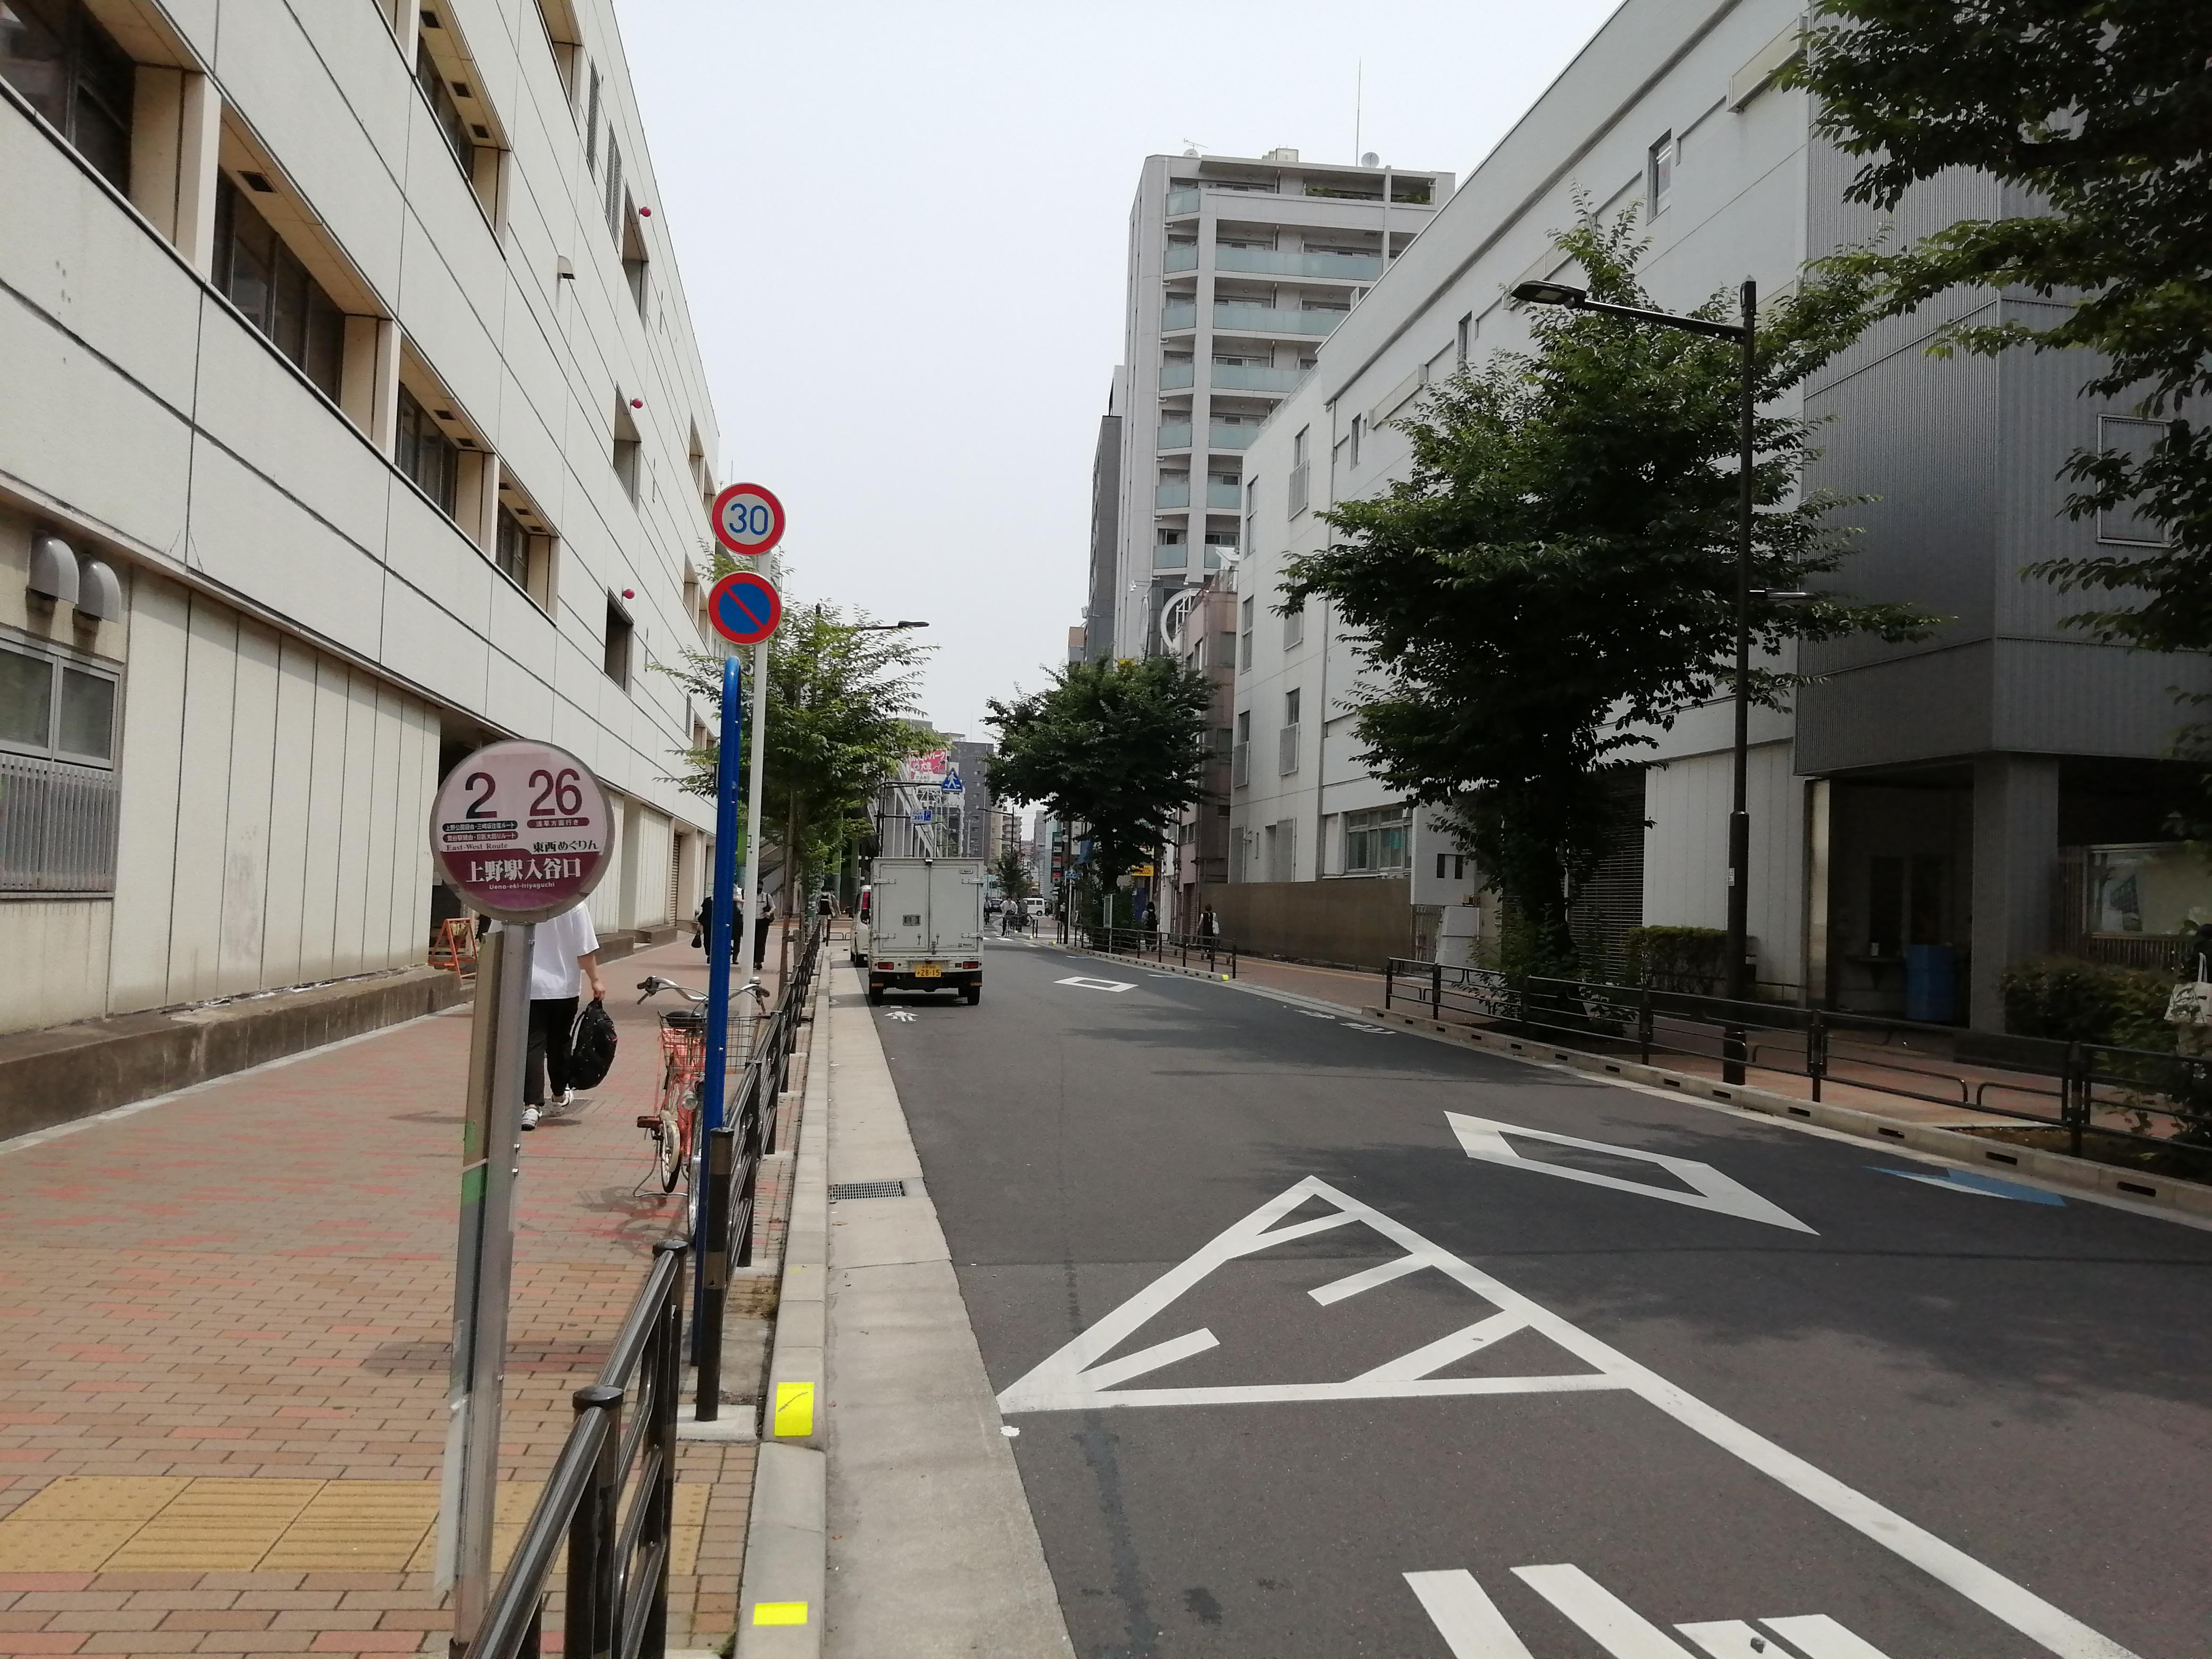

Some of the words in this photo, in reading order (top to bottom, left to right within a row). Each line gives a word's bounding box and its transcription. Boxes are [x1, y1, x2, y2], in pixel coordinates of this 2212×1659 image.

[729, 503, 768, 536] 30
[465, 772, 497, 819] 2
[529, 768, 582, 816] 26
[533, 840, 598, 852] 東西めぐりん
[466, 858, 581, 883] 上野駅入谷口
